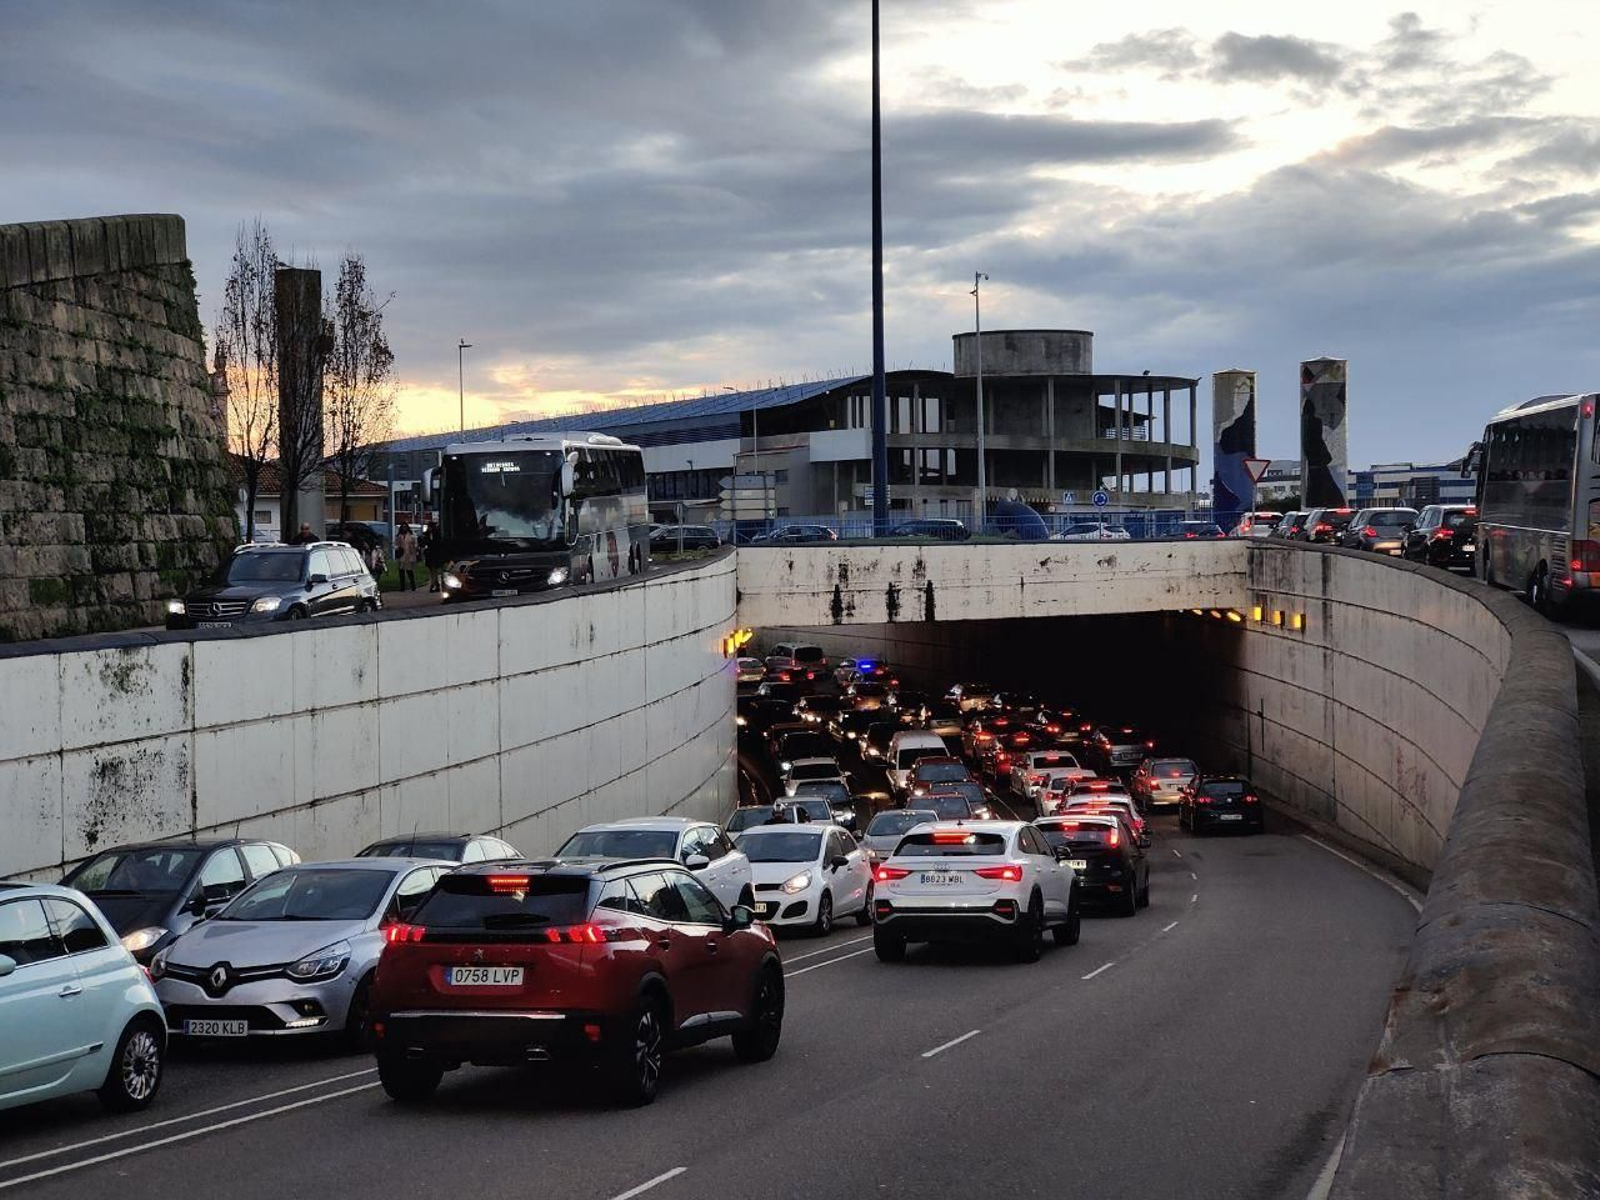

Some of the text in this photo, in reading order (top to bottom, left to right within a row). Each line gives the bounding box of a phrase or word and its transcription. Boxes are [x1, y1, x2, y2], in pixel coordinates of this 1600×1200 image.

[455, 969, 520, 983] 0758 LVP
[191, 1022, 245, 1035] 2320 KLB
